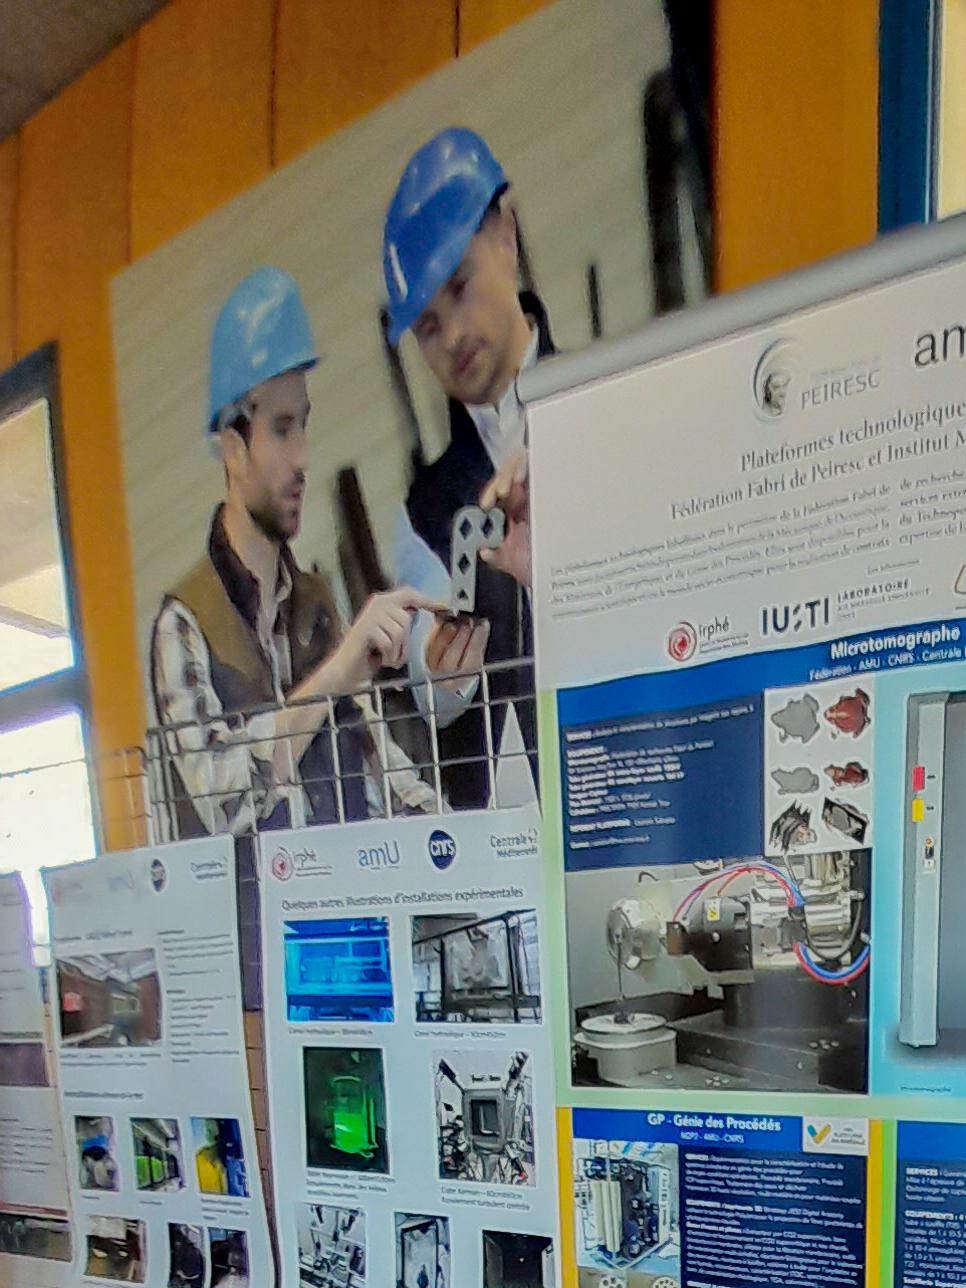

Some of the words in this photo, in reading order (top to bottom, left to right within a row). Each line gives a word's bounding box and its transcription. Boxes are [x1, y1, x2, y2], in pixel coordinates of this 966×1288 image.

[801, 370, 880, 408] PEIRESC
[741, 435, 834, 472] Plateformes
[671, 488, 743, 520] Fédération
[748, 473, 787, 500] Fabri
[790, 469, 807, 490] de
[812, 456, 863, 484] Peiresc
[868, 450, 882, 467] et
[887, 434, 949, 462] Institut
[837, 578, 908, 604] LABORATOIRE
[830, 624, 961, 660] Microtomographe
[859, 657, 881, 671] AMU
[922, 646, 962, 662] Centrale
[358, 840, 400, 867] amU
[455, 887, 524, 902] expérimentales
[647, 1112, 666, 1126] GP
[674, 1113, 703, 1128] Génie
[706, 1115, 724, 1129] des
[726, 1115, 782, 1132] Procédés
